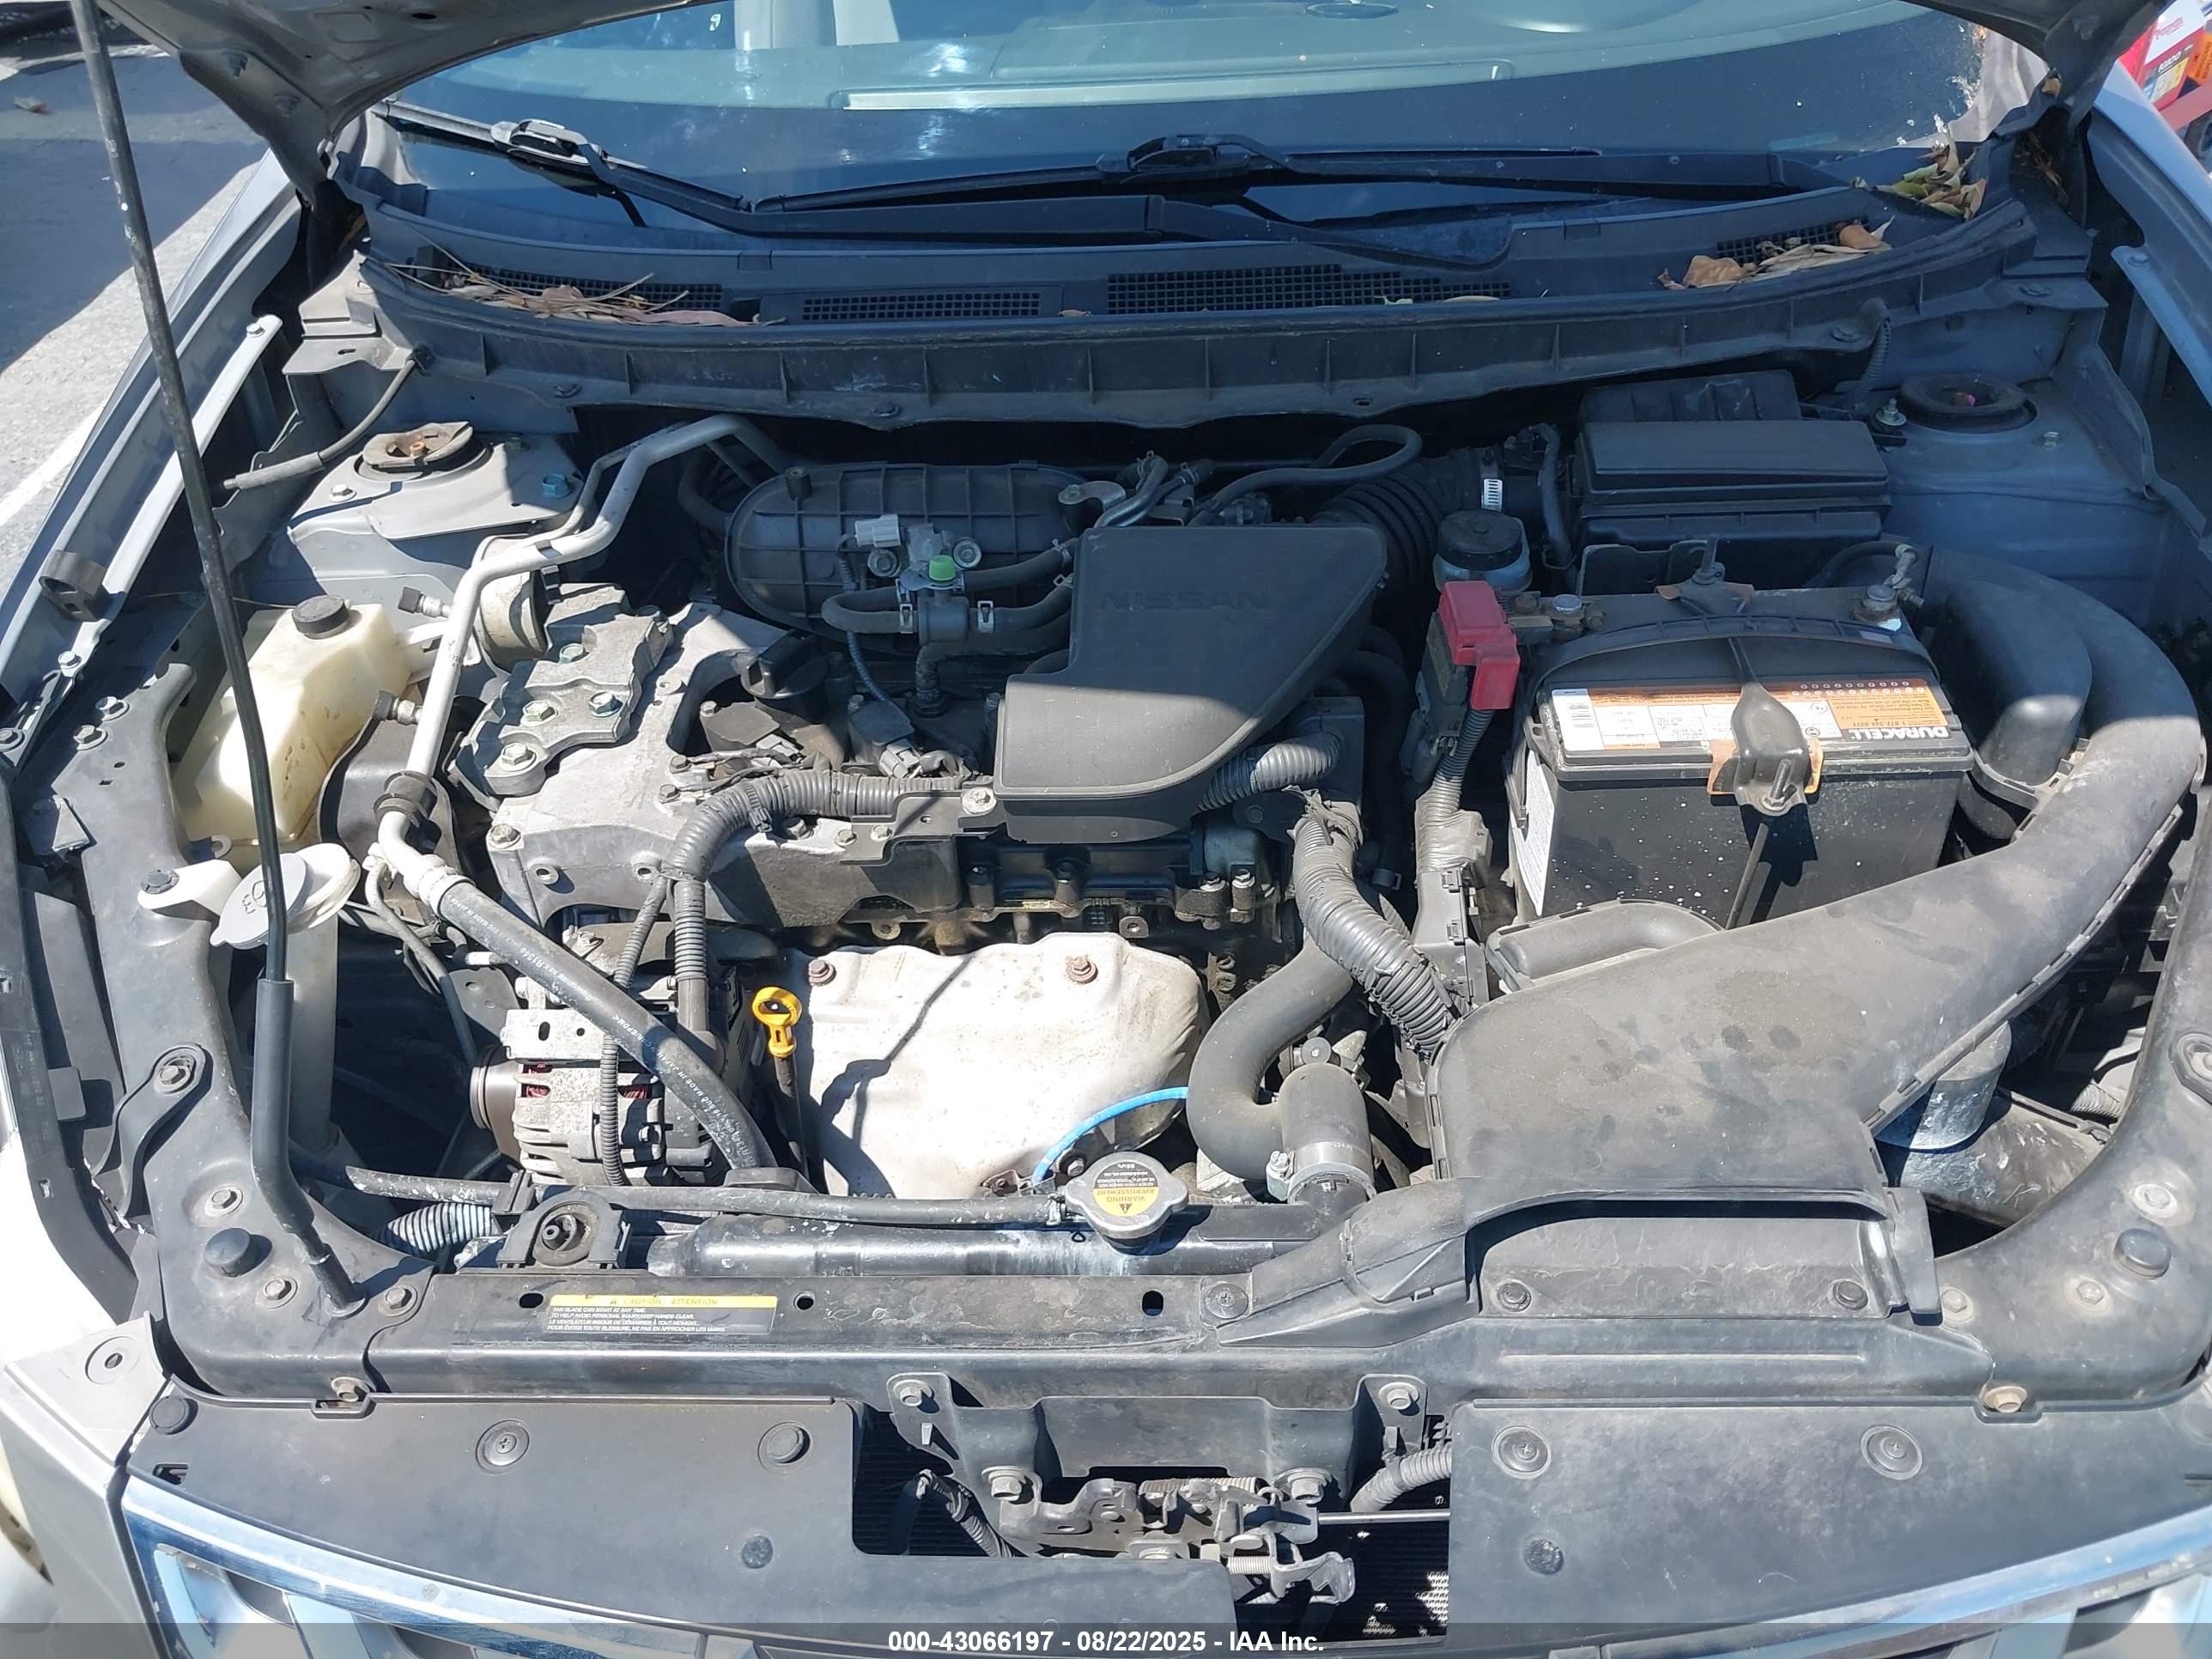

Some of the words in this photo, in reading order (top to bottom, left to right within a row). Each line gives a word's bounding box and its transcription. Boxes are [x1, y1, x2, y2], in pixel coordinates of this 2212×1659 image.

[1099, 590, 1269, 611] NISSAN
[1848, 726, 1949, 740] DURACELL
[657, 1049, 679, 1072] JAPAN
[677, 1071, 687, 1079] IN
[685, 1079, 704, 1097] MADE
